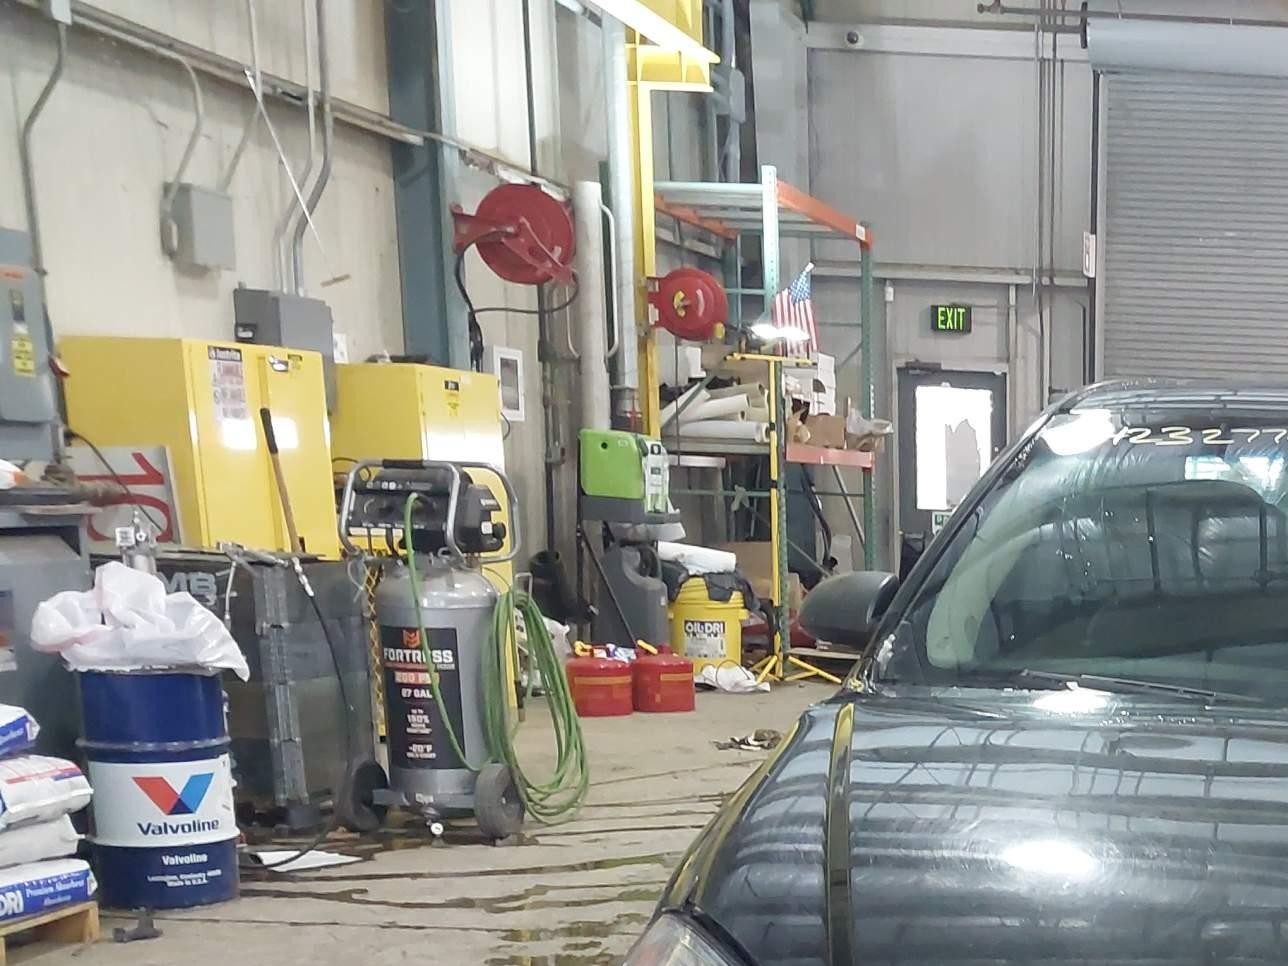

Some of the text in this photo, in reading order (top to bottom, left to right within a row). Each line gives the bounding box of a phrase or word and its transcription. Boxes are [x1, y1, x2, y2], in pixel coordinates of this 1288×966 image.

[938, 307, 966, 330] EXIT
[137, 818, 220, 836] Valvoline
[162, 853, 208, 866] Valvoline
